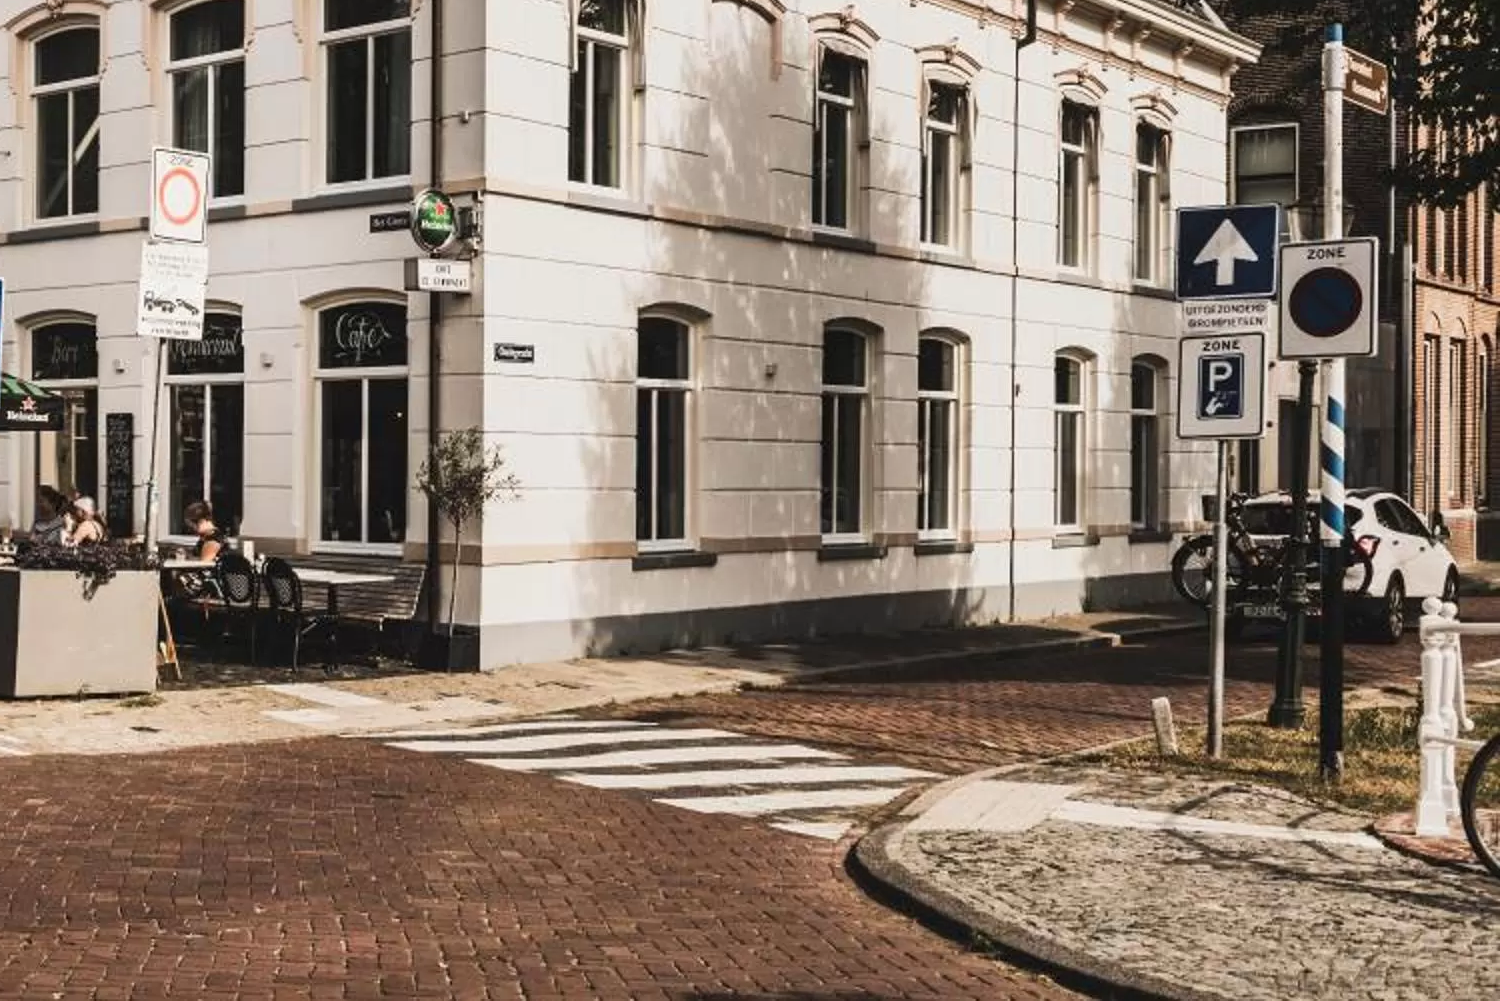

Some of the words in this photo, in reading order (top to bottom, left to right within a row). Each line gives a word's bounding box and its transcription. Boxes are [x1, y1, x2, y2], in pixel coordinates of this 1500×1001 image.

[1307, 247, 1346, 261] ZONE
[1203, 339, 1241, 352] ZONE
[1209, 361, 1233, 393] P
